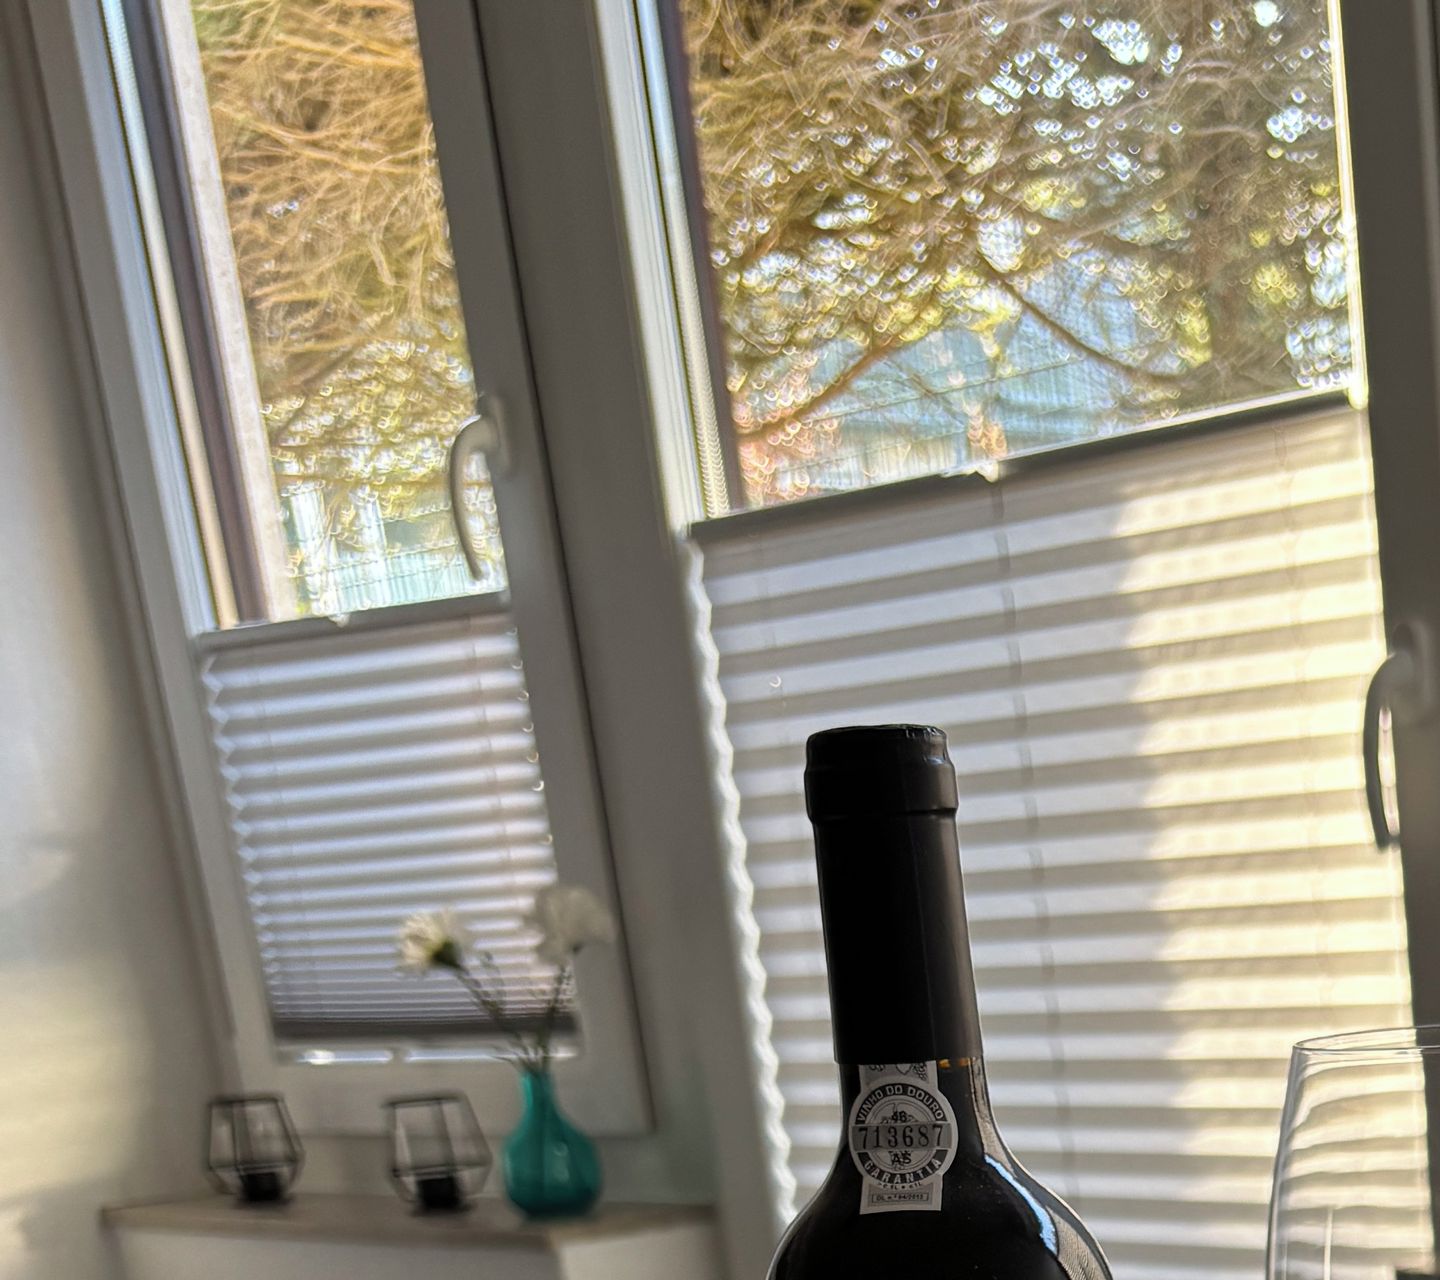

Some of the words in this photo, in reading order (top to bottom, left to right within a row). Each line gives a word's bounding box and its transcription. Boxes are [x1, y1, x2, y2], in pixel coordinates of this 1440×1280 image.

[857, 1090, 883, 1121] VINHO
[886, 1084, 903, 1096] DO
[907, 1086, 944, 1119] DOURO
[858, 1124, 943, 1149] 713687
[863, 1159, 942, 1184] GARANTIA
